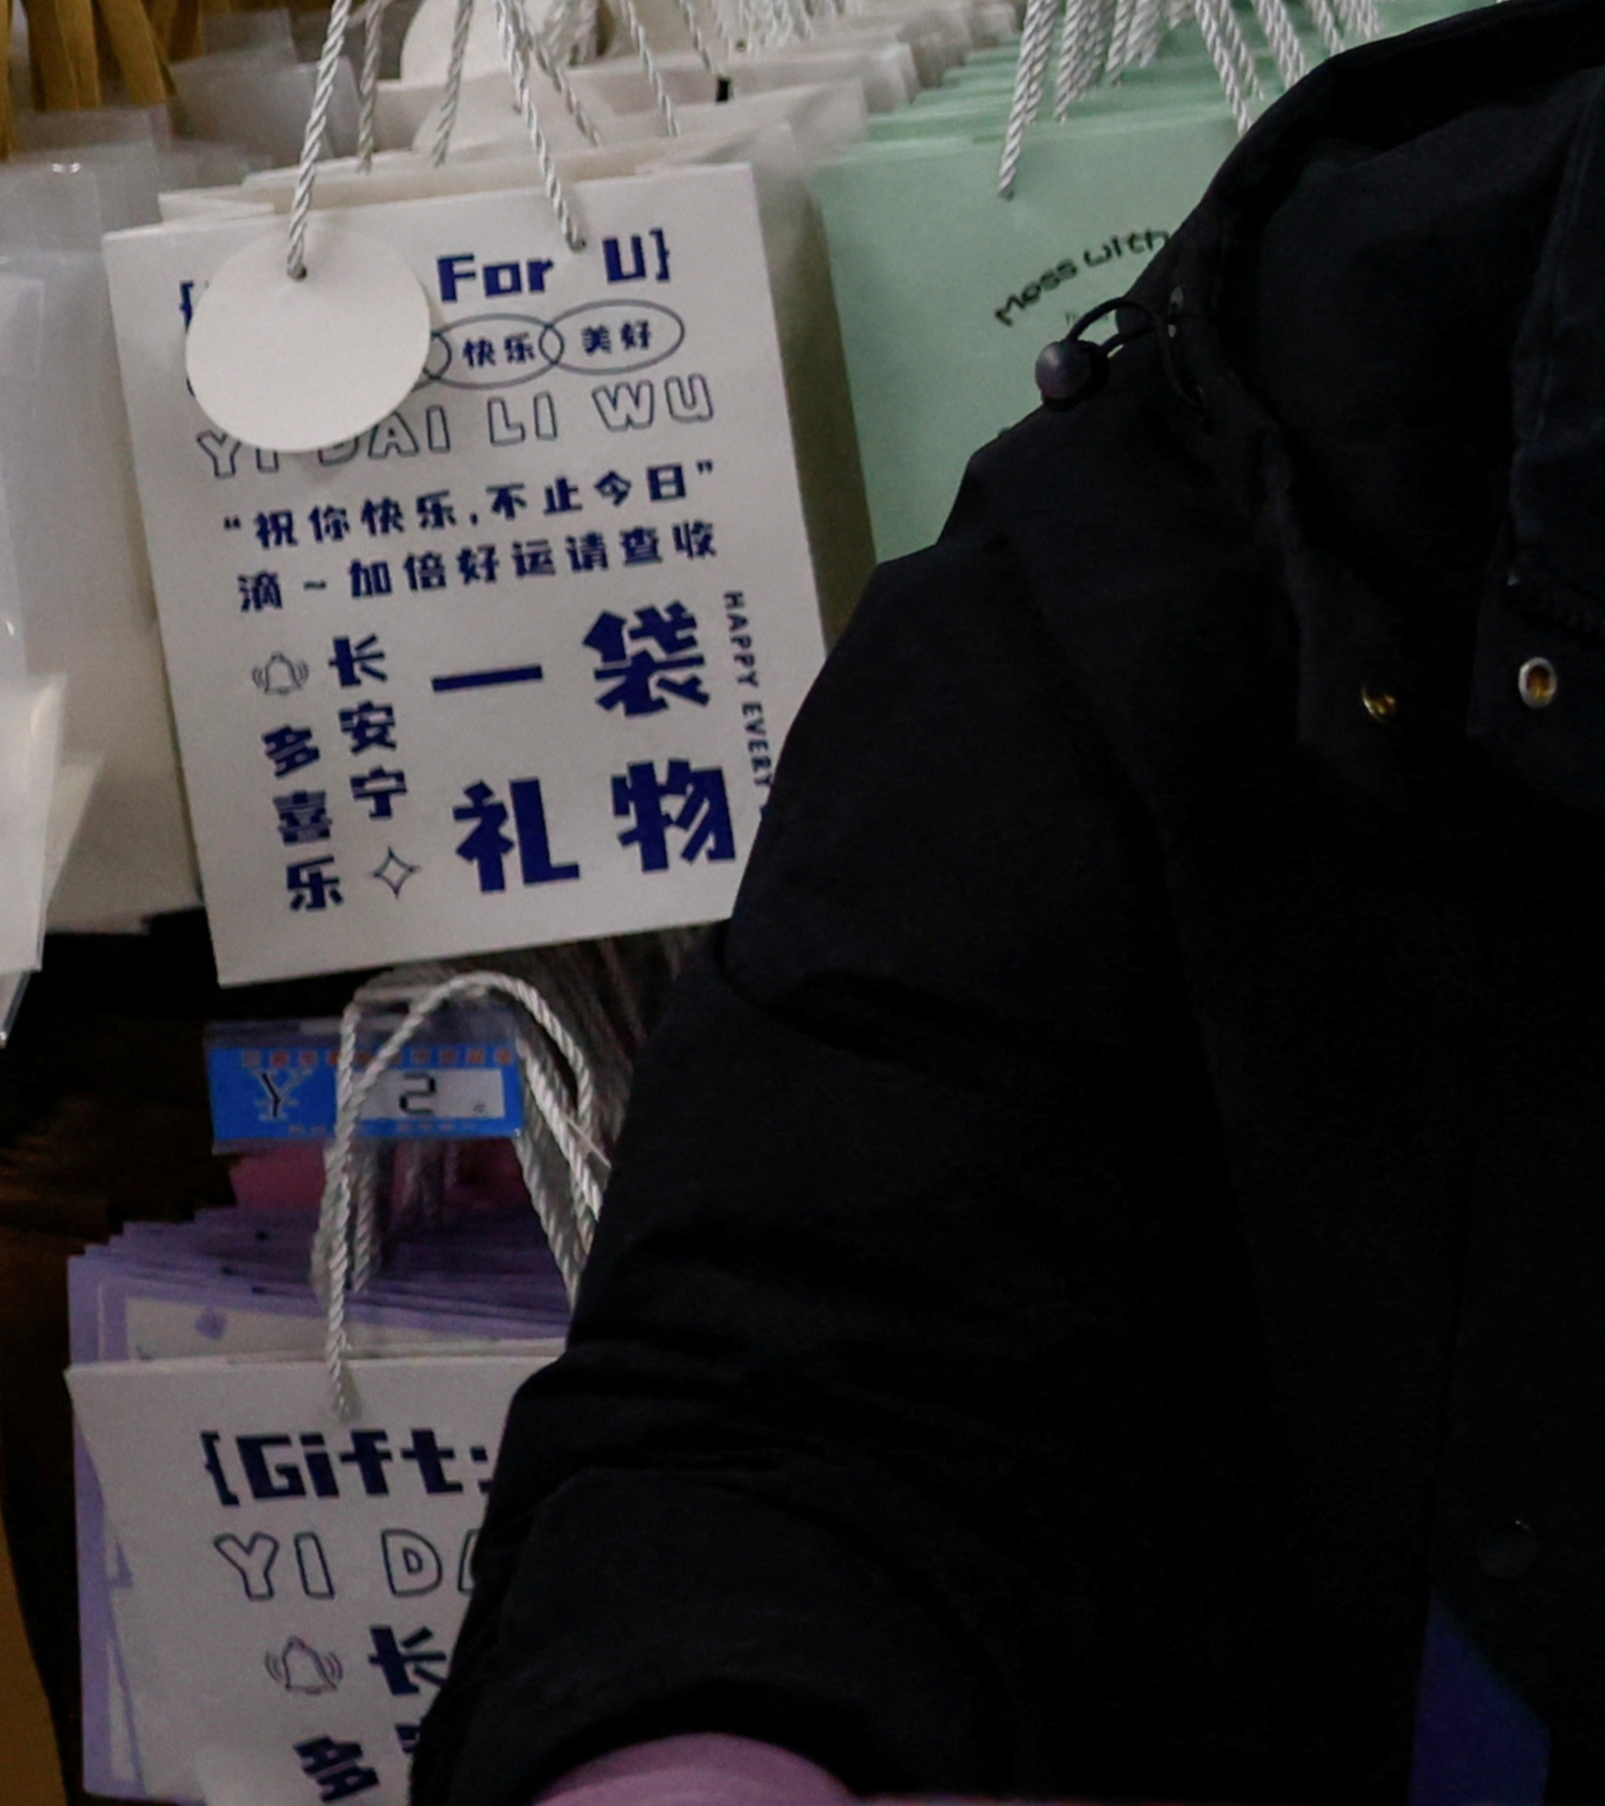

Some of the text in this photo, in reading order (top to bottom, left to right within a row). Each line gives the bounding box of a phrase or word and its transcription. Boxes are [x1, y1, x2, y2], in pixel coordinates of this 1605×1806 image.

[436, 251, 555, 304] For
[462, 319, 653, 370] 快乐 美好
[486, 392, 557, 448] LI
[592, 373, 717, 434] WU
[723, 590, 759, 689] HAPPY
[399, 1072, 437, 1116] 2
[212, 1529, 336, 1602] YI
